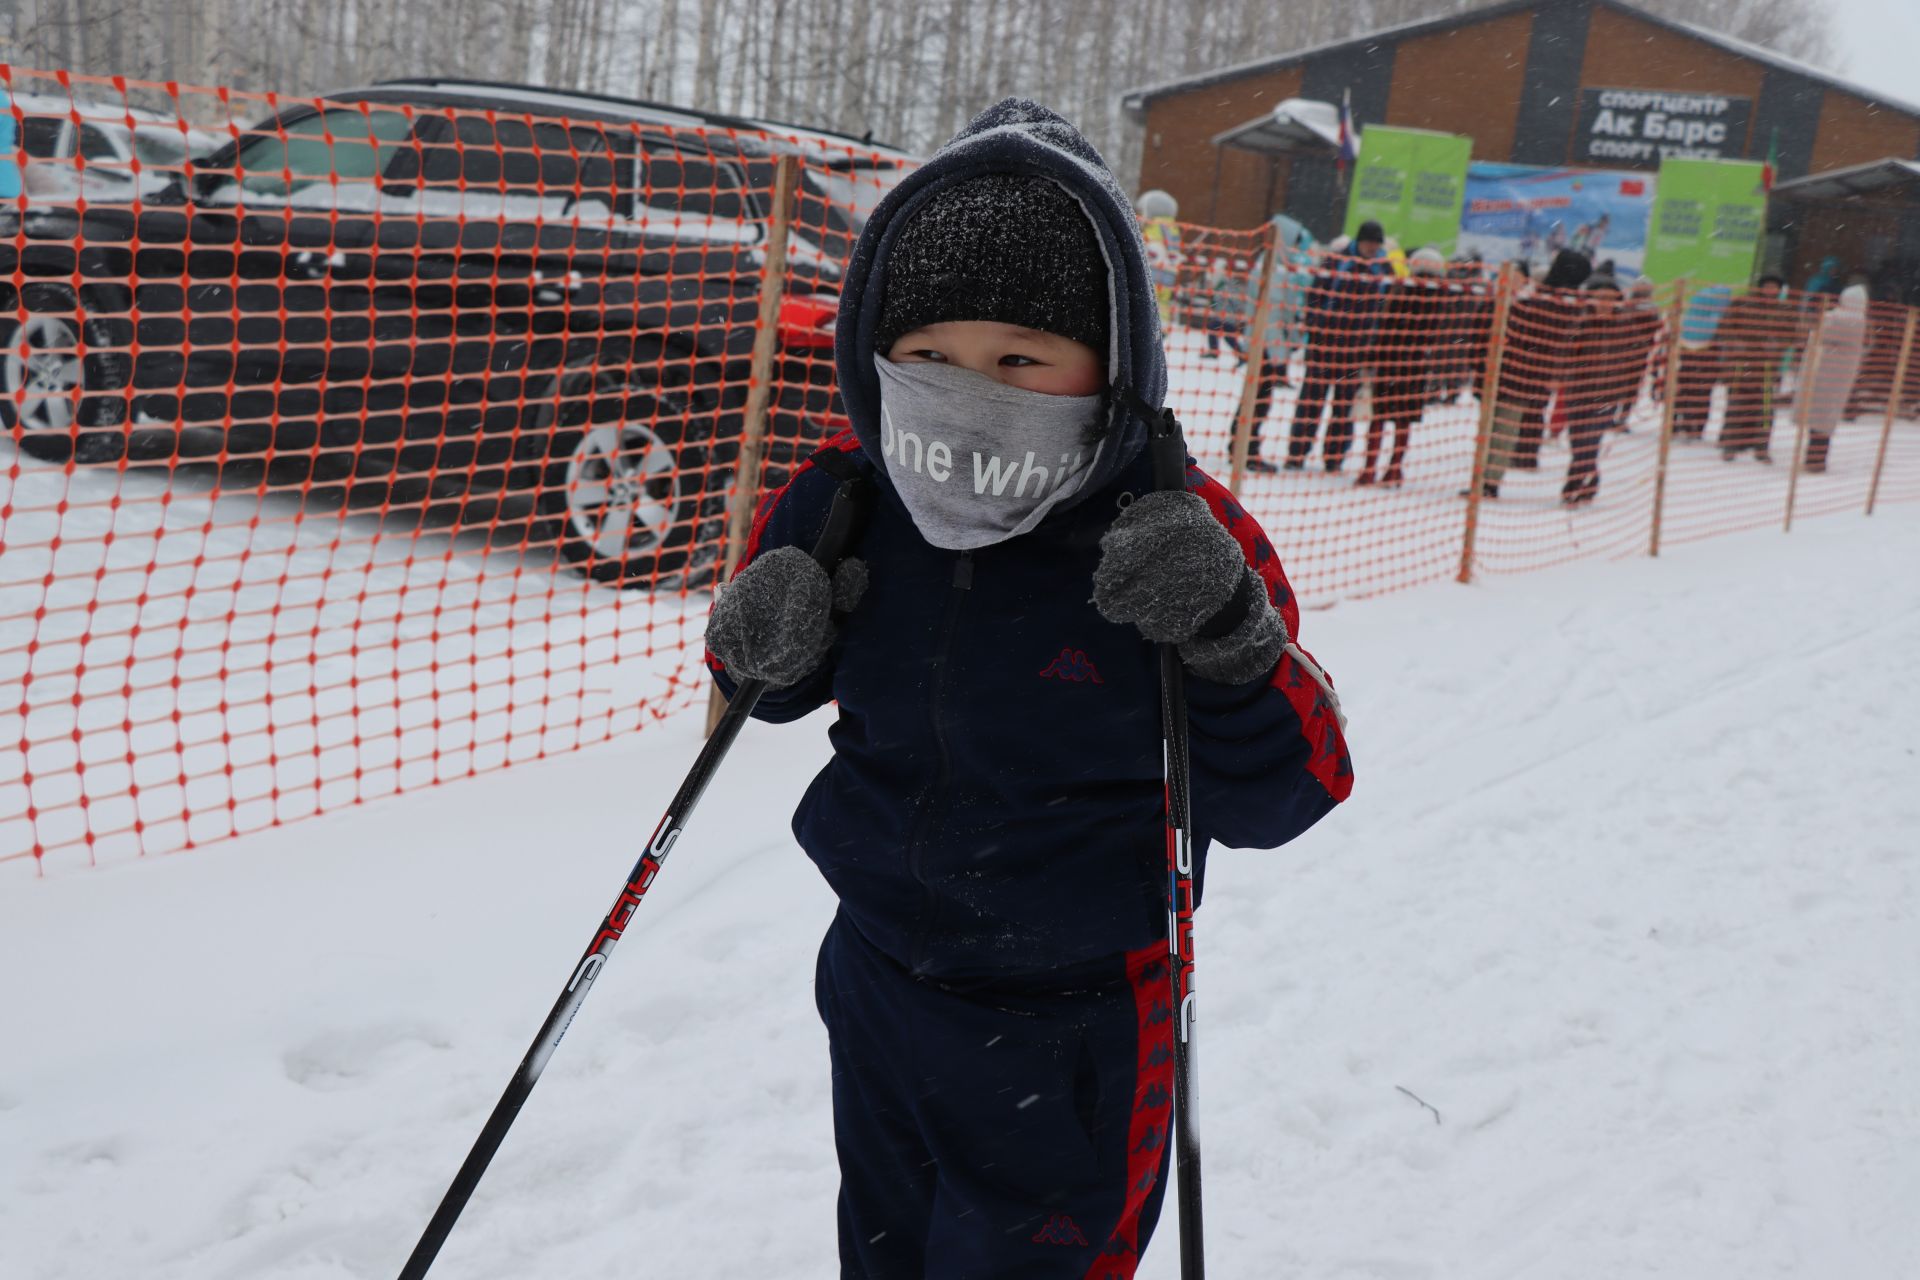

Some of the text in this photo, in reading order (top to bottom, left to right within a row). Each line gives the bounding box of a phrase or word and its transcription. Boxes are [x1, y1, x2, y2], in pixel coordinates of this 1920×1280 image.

[1598, 91, 1729, 115] СПОРТЦЕНТР
[1591, 109, 1727, 145] Ак Барс
[1589, 140, 1655, 160] СПОРТ
